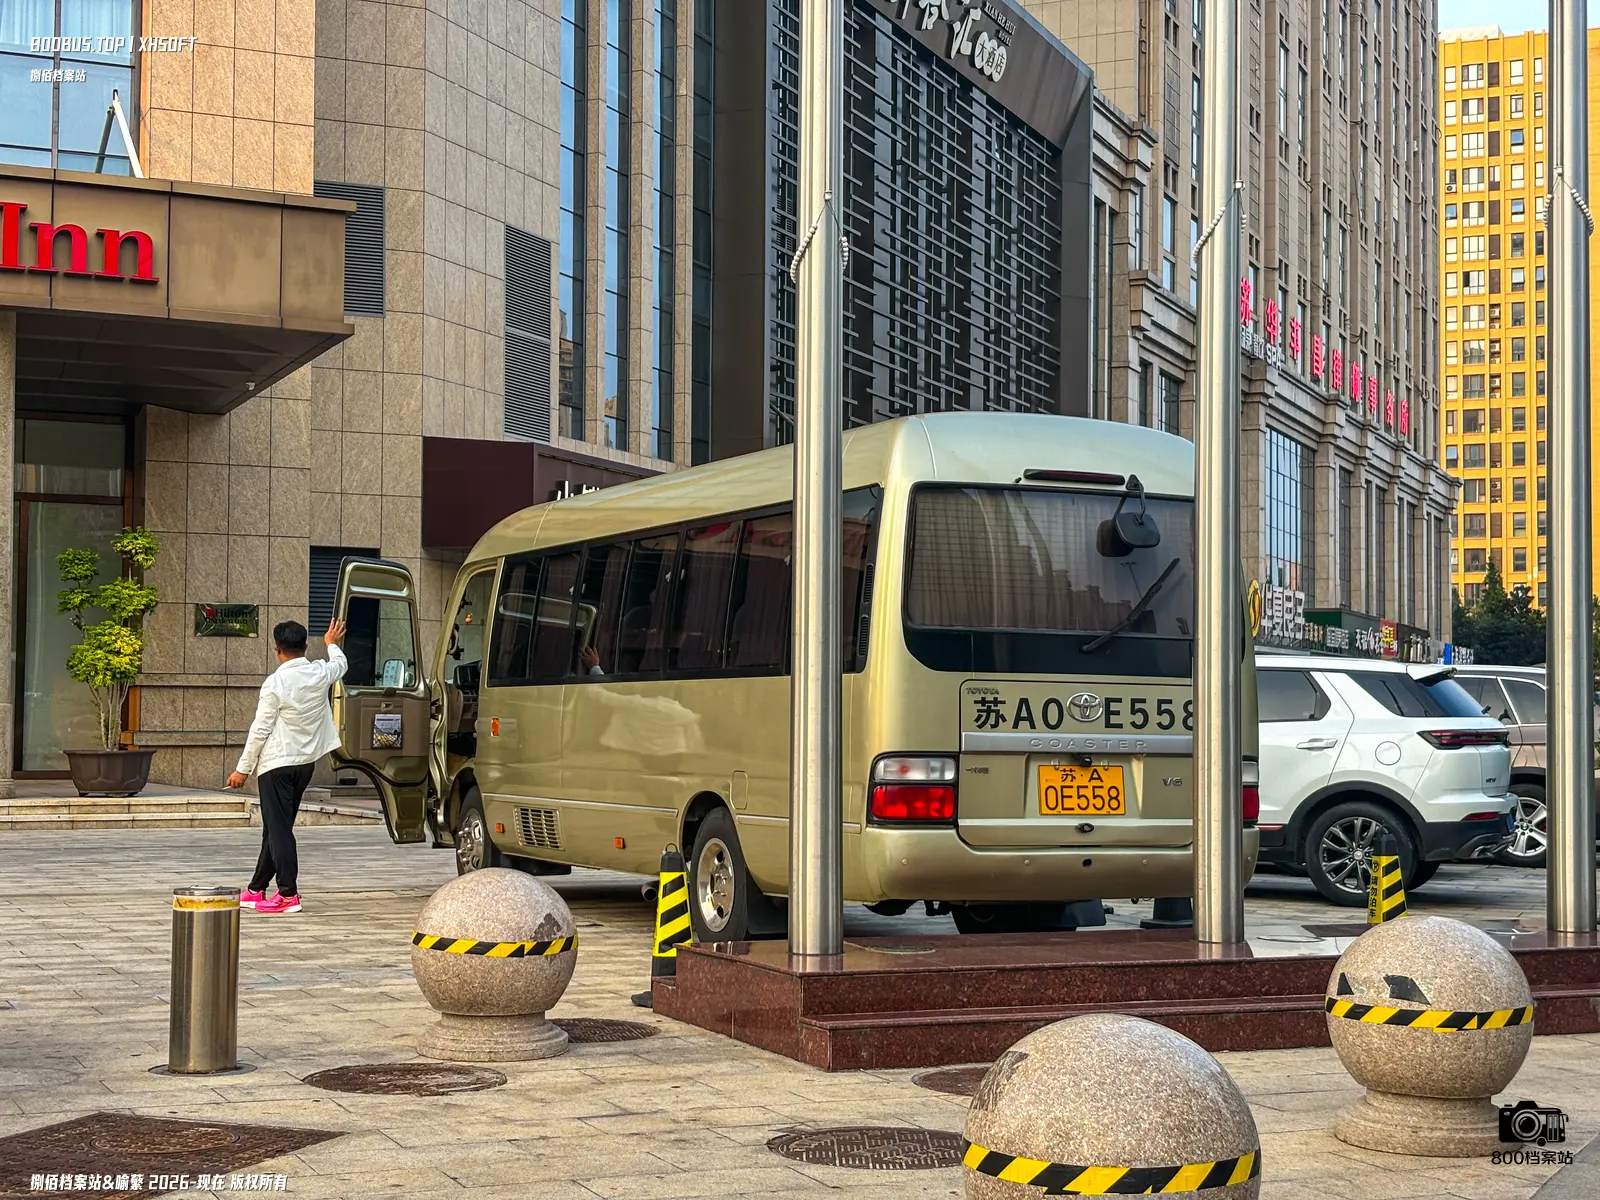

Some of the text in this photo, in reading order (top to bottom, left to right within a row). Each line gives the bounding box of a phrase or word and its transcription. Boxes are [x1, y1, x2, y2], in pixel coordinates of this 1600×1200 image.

[972, 34, 1007, 80] 大酒店
[0, 200, 160, 285] Inn
[966, 687, 1000, 695] TOYOTA
[1029, 738, 1147, 751] COASTER
[1162, 776, 1183, 787] V6
[1044, 785, 1121, 811] 0E558
[1369, 876, 1378, 917] 请勿泊车
